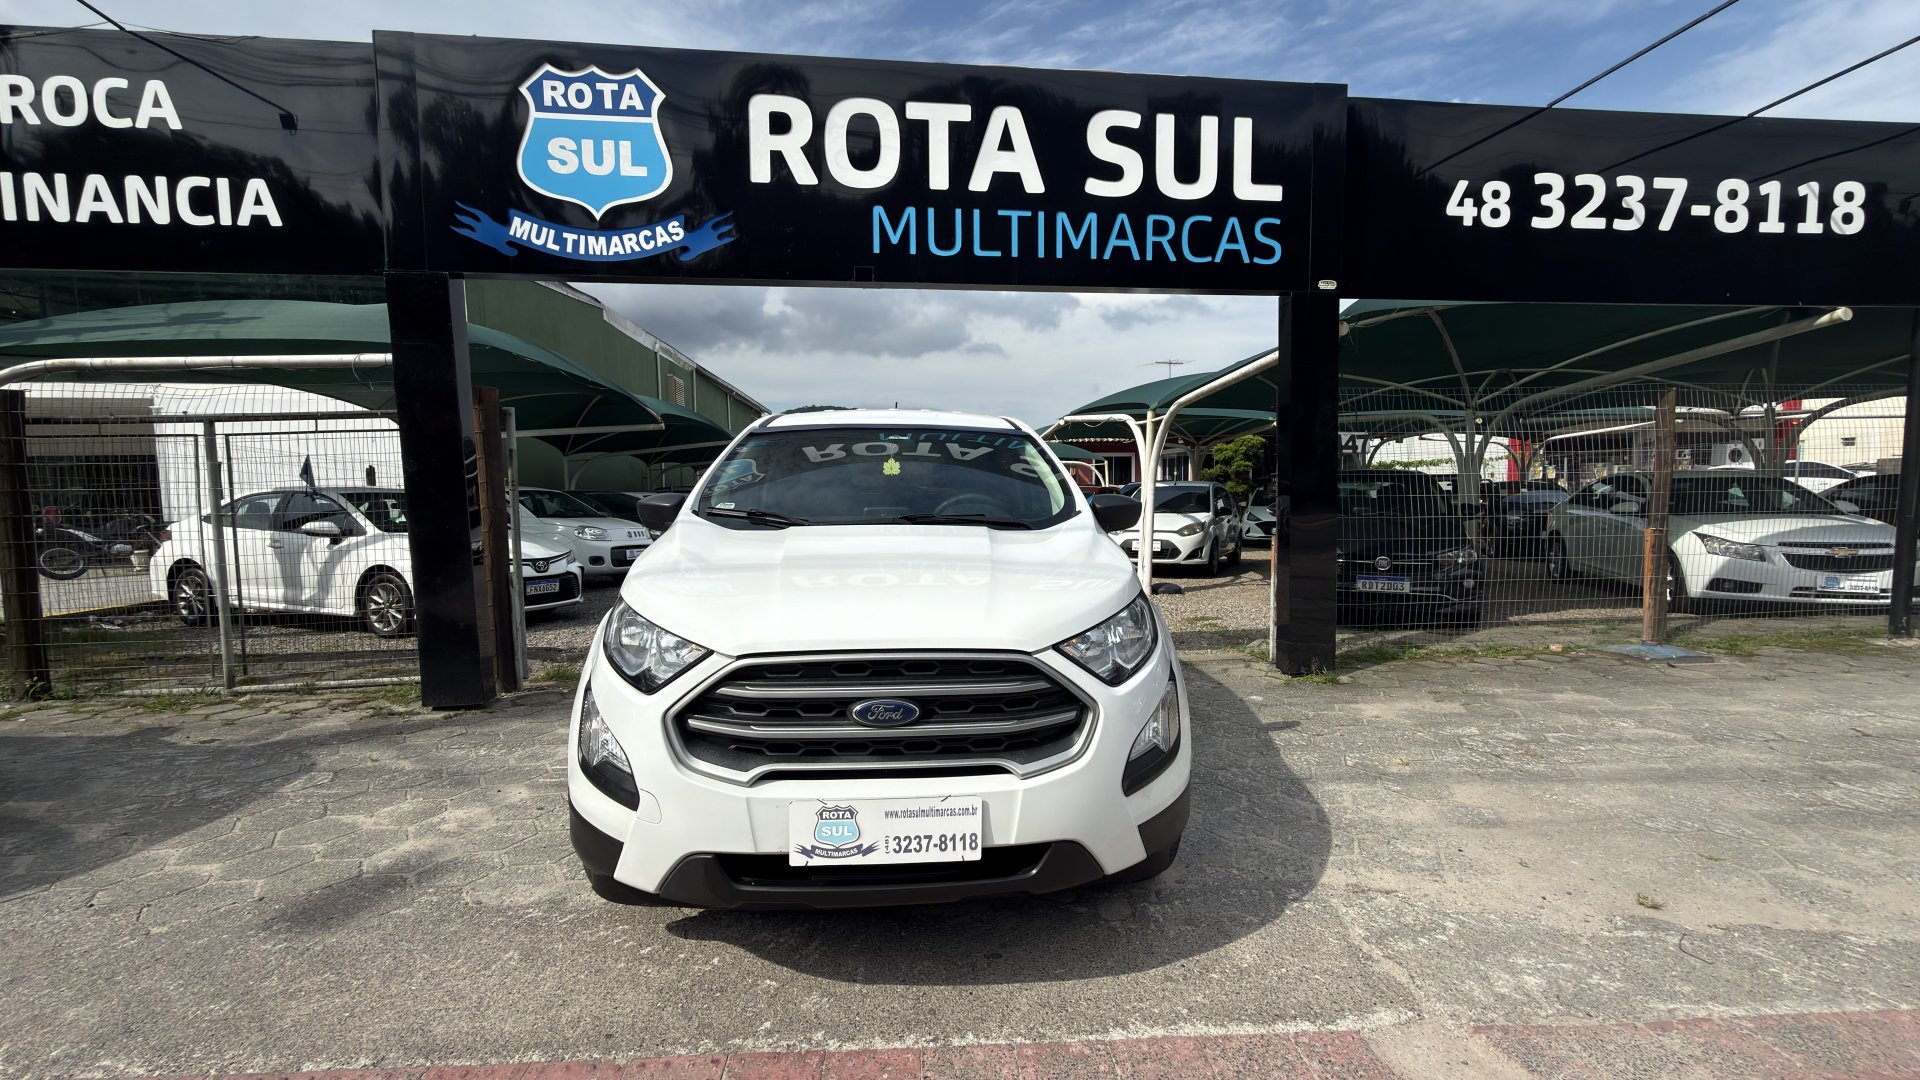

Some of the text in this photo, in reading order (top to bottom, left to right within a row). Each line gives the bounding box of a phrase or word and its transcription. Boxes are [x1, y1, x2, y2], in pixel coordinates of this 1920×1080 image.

[0, 74, 183, 131] ROCA
[541, 79, 645, 111] ROTA
[546, 135, 649, 178] SUL
[747, 92, 1284, 202] ROTA SUL
[0, 171, 284, 227] INANCIA
[1444, 171, 1867, 236] 48 3237-8118
[507, 215, 686, 257] MULTIMARCAS
[872, 203, 1283, 266] MULTIMARCAS
[867, 704, 904, 721] Ford
[821, 823, 854, 837] SUL
[822, 810, 852, 820] ROTA
[884, 804, 979, 820] www.rotasulmultimarcas.com.br
[814, 847, 859, 858] MULTIMARCAS
[892, 832, 979, 854] 3237-8118
